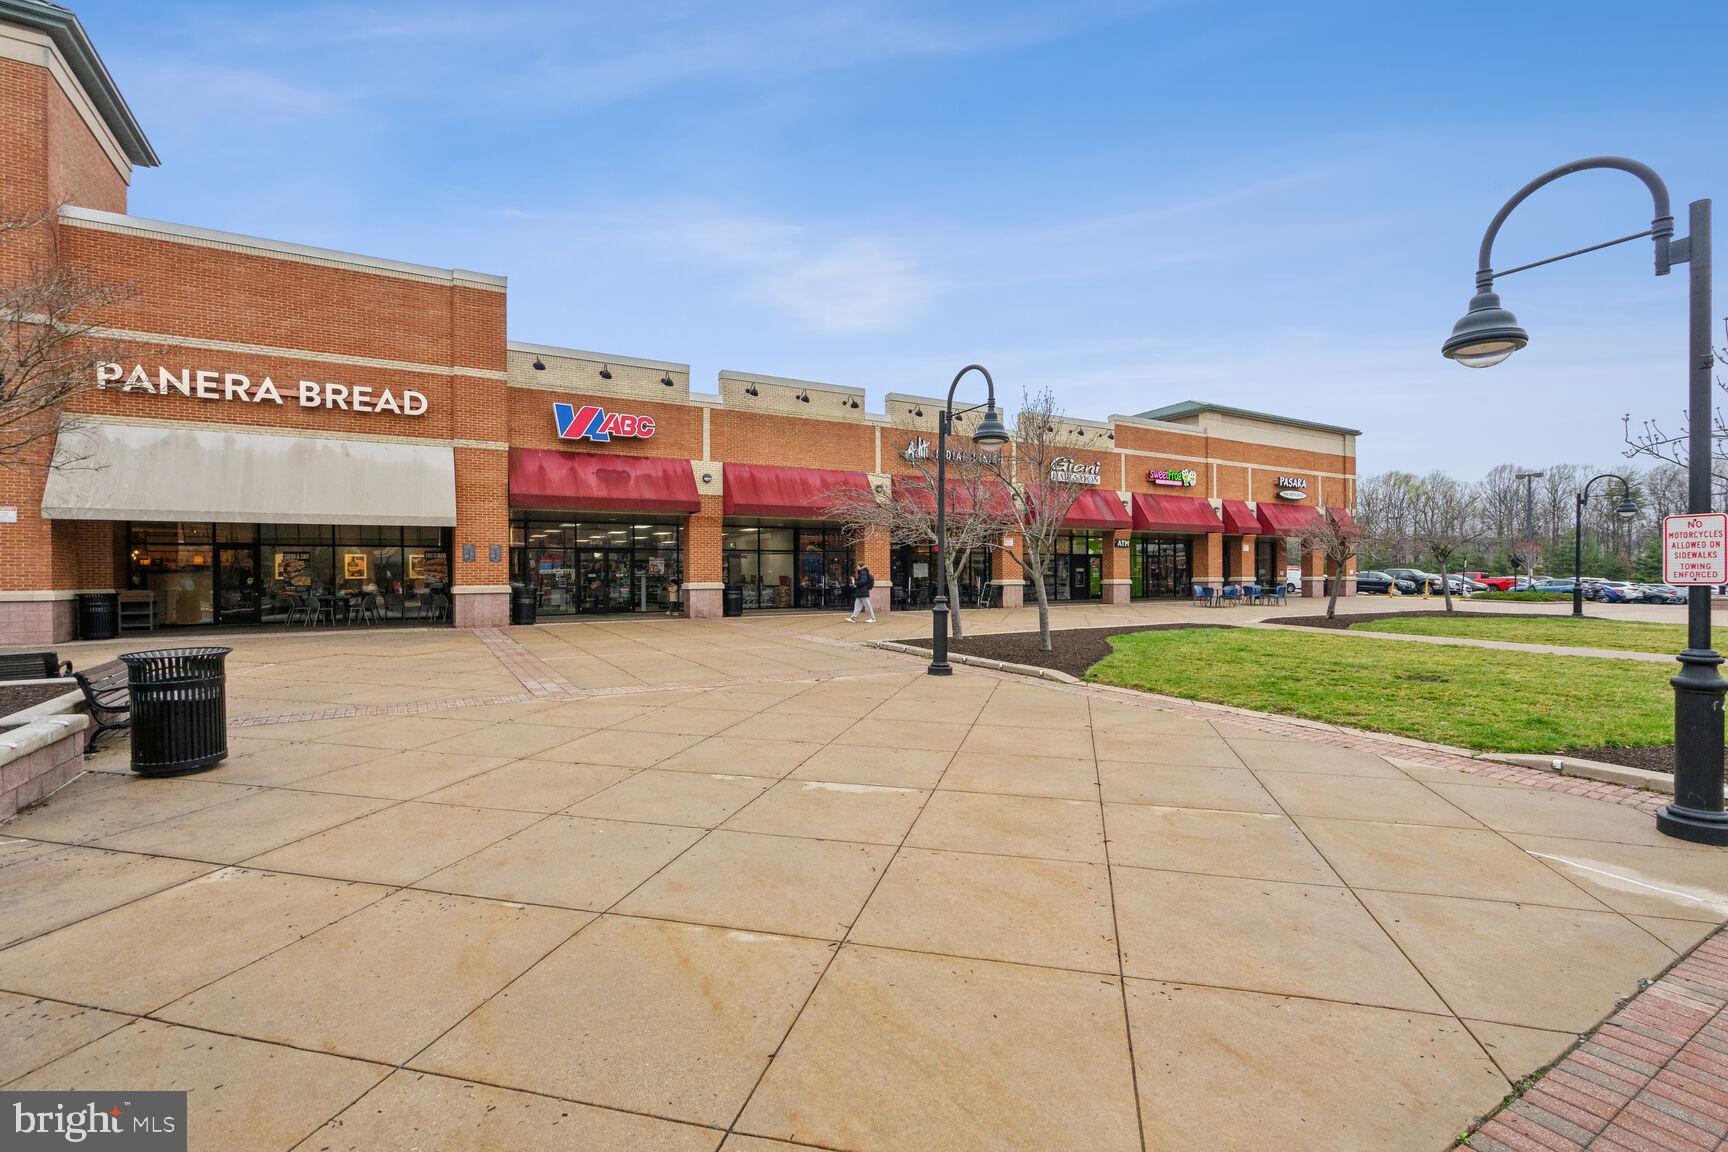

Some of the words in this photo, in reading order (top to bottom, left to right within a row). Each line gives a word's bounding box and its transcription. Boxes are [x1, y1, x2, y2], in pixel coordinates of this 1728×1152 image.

[97, 361, 284, 405] PANERA
[299, 380, 429, 416] BREAD
[596, 412, 656, 439] ABC
[1687, 520, 1703, 528] NO
[1668, 530, 1723, 539] MOTORCYCLES
[1671, 541, 1707, 549] ALLOWED
[1709, 540, 1721, 549] ON
[1674, 550, 1718, 560] SIDEWALKS
[1680, 562, 1712, 570] TOWING
